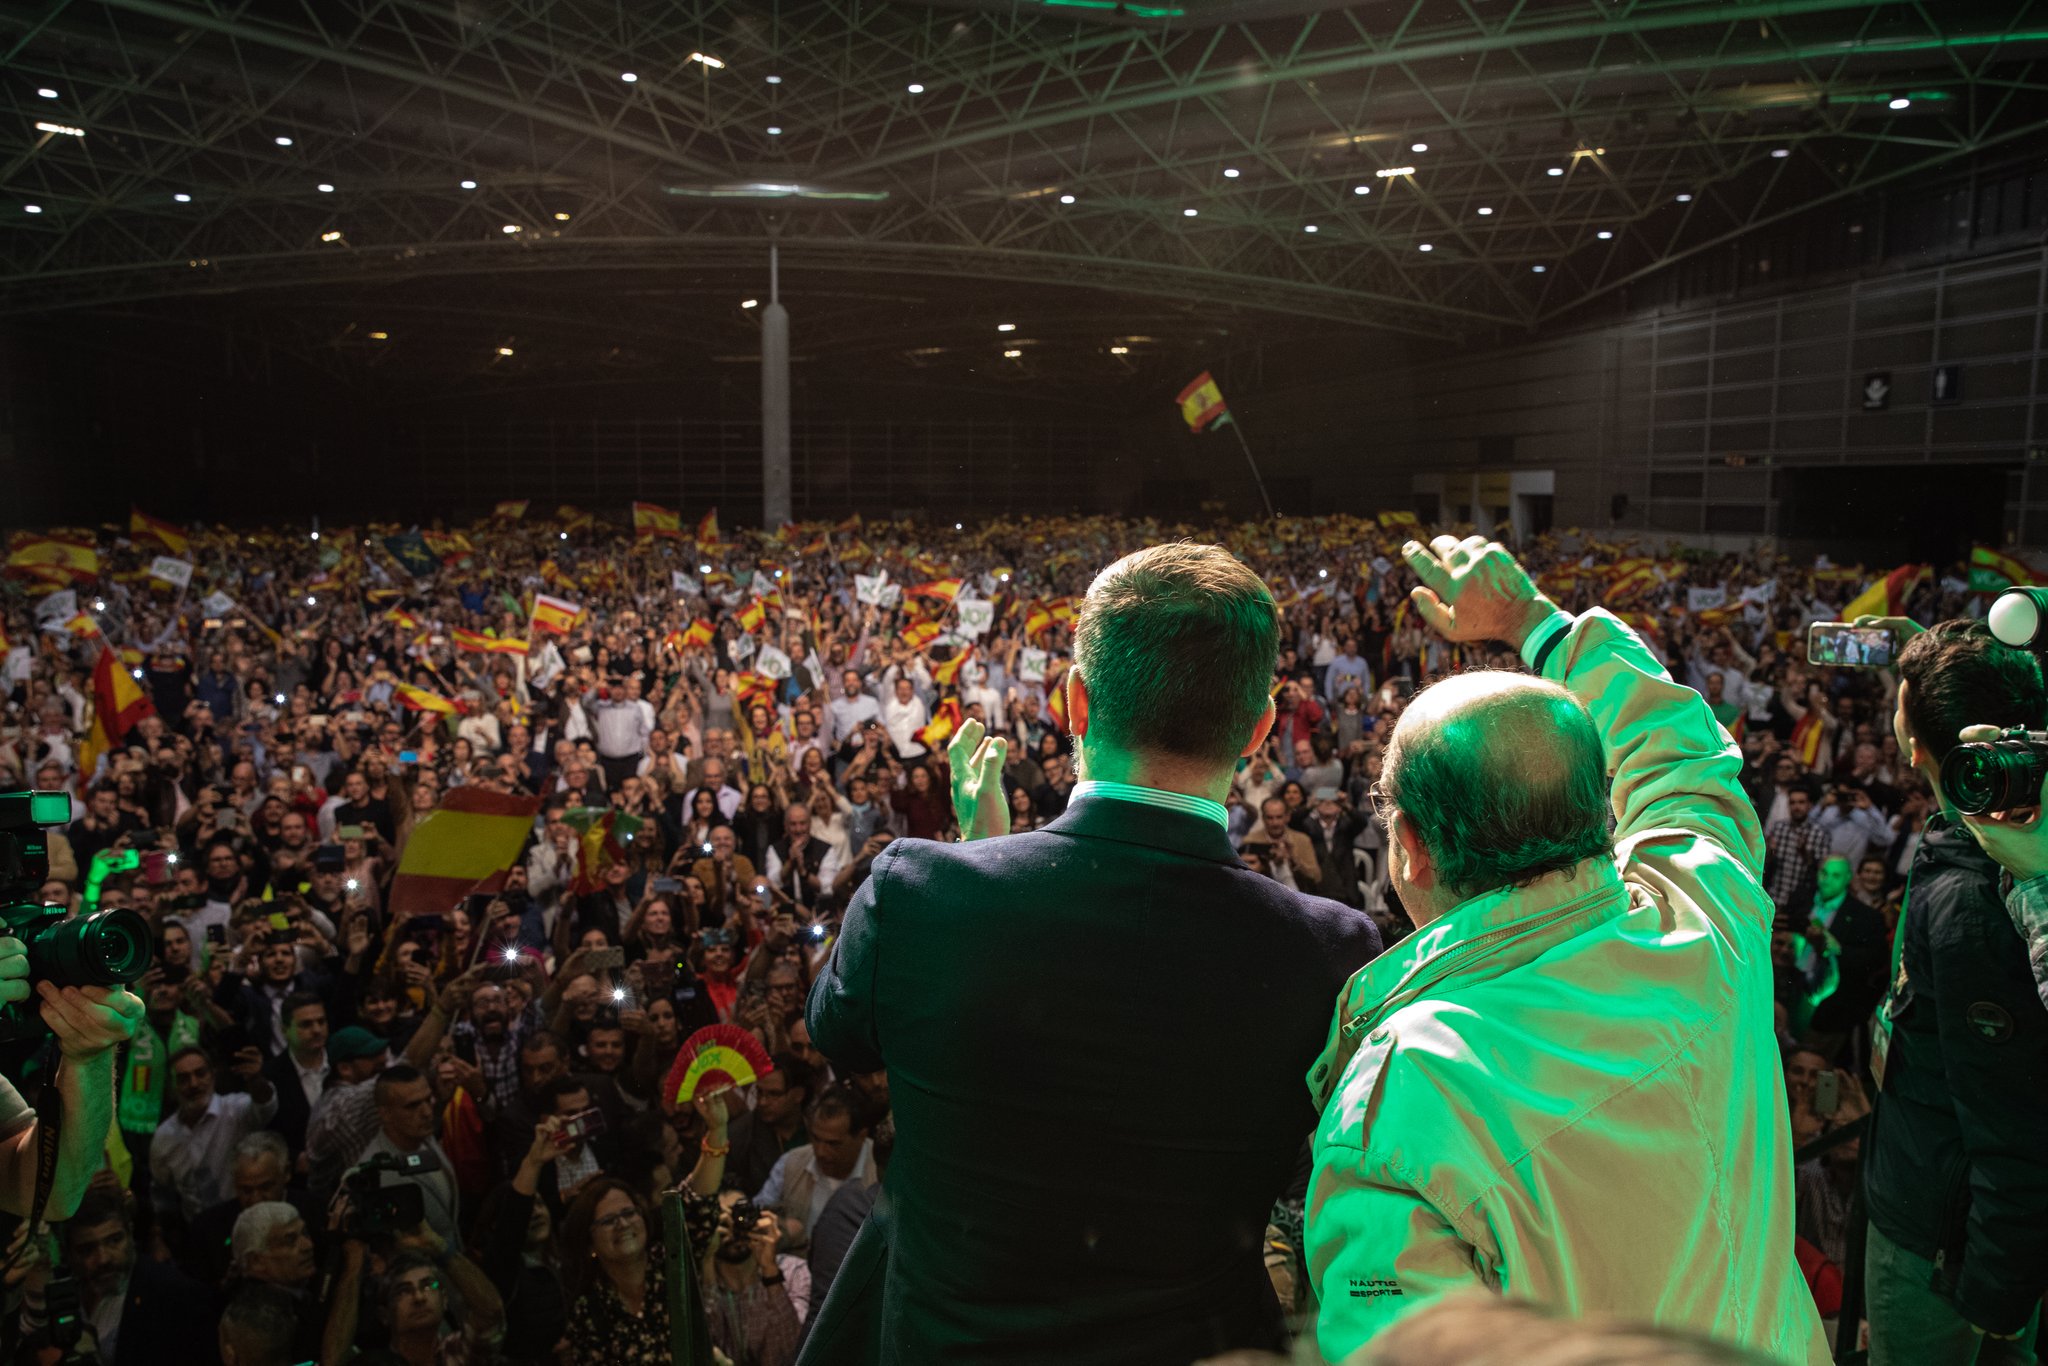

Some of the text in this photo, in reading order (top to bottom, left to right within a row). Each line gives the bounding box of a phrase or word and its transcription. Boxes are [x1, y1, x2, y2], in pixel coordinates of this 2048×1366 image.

[46, 907, 67, 915] Nikon
[1349, 1279, 1398, 1287] NAUTIC
[1359, 1289, 1392, 1298] SPORT
